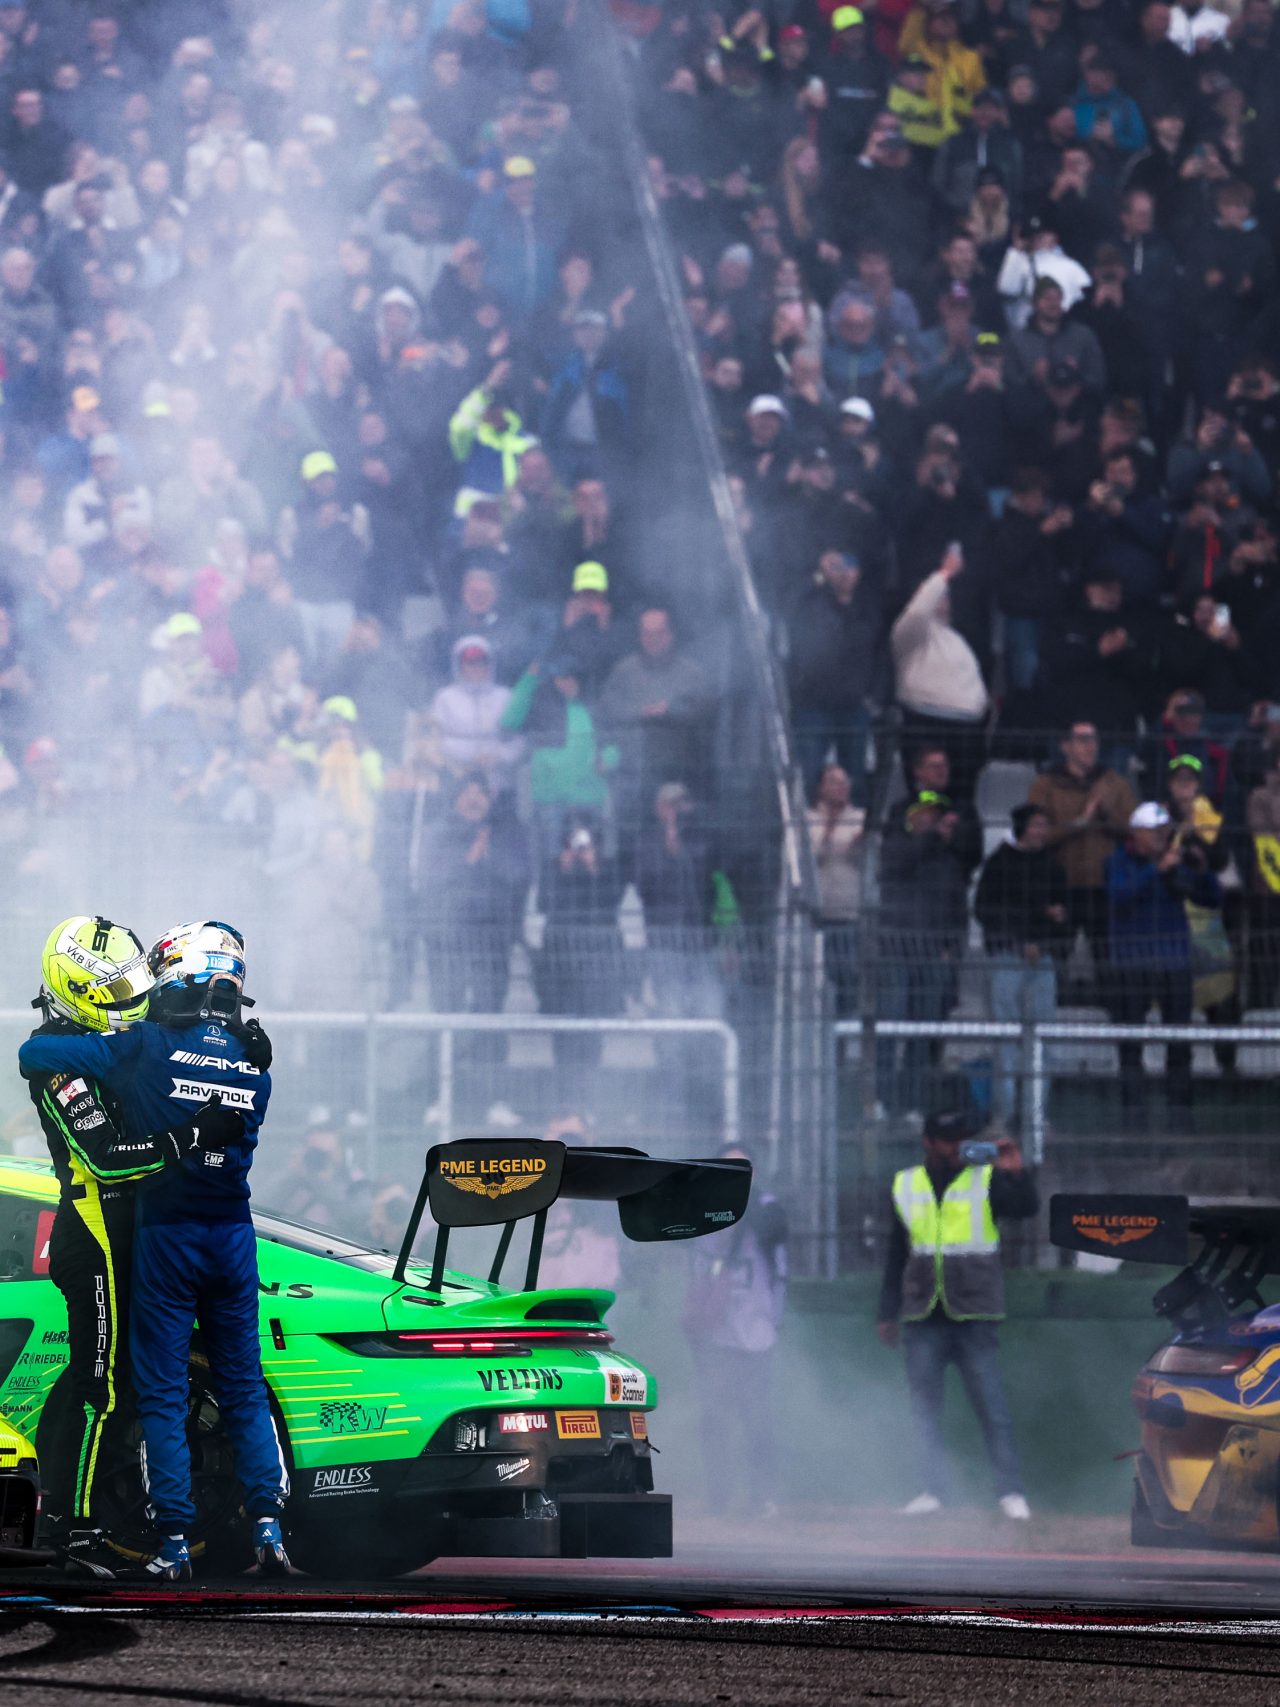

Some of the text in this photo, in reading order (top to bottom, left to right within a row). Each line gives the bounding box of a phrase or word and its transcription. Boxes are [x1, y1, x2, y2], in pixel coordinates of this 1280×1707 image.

[67, 945, 85, 963] VKB
[180, 1084, 250, 1104] RAVENOL
[68, 1102, 87, 1117] VKB
[440, 1159, 546, 1174] PME LEGEND
[1073, 1215, 1158, 1227] PME LEGEND
[94, 1275, 107, 1377] PORSCHE
[34, 1353, 68, 1364] RIEDEL
[9, 1376, 42, 1388] ENDLESS
[477, 1368, 563, 1392] VELTINS
[503, 1415, 548, 1432] MOTUL
[562, 1415, 597, 1434] PIRELLI
[314, 1466, 372, 1487] ENDLESS
[496, 1458, 531, 1477] Milwaukee
